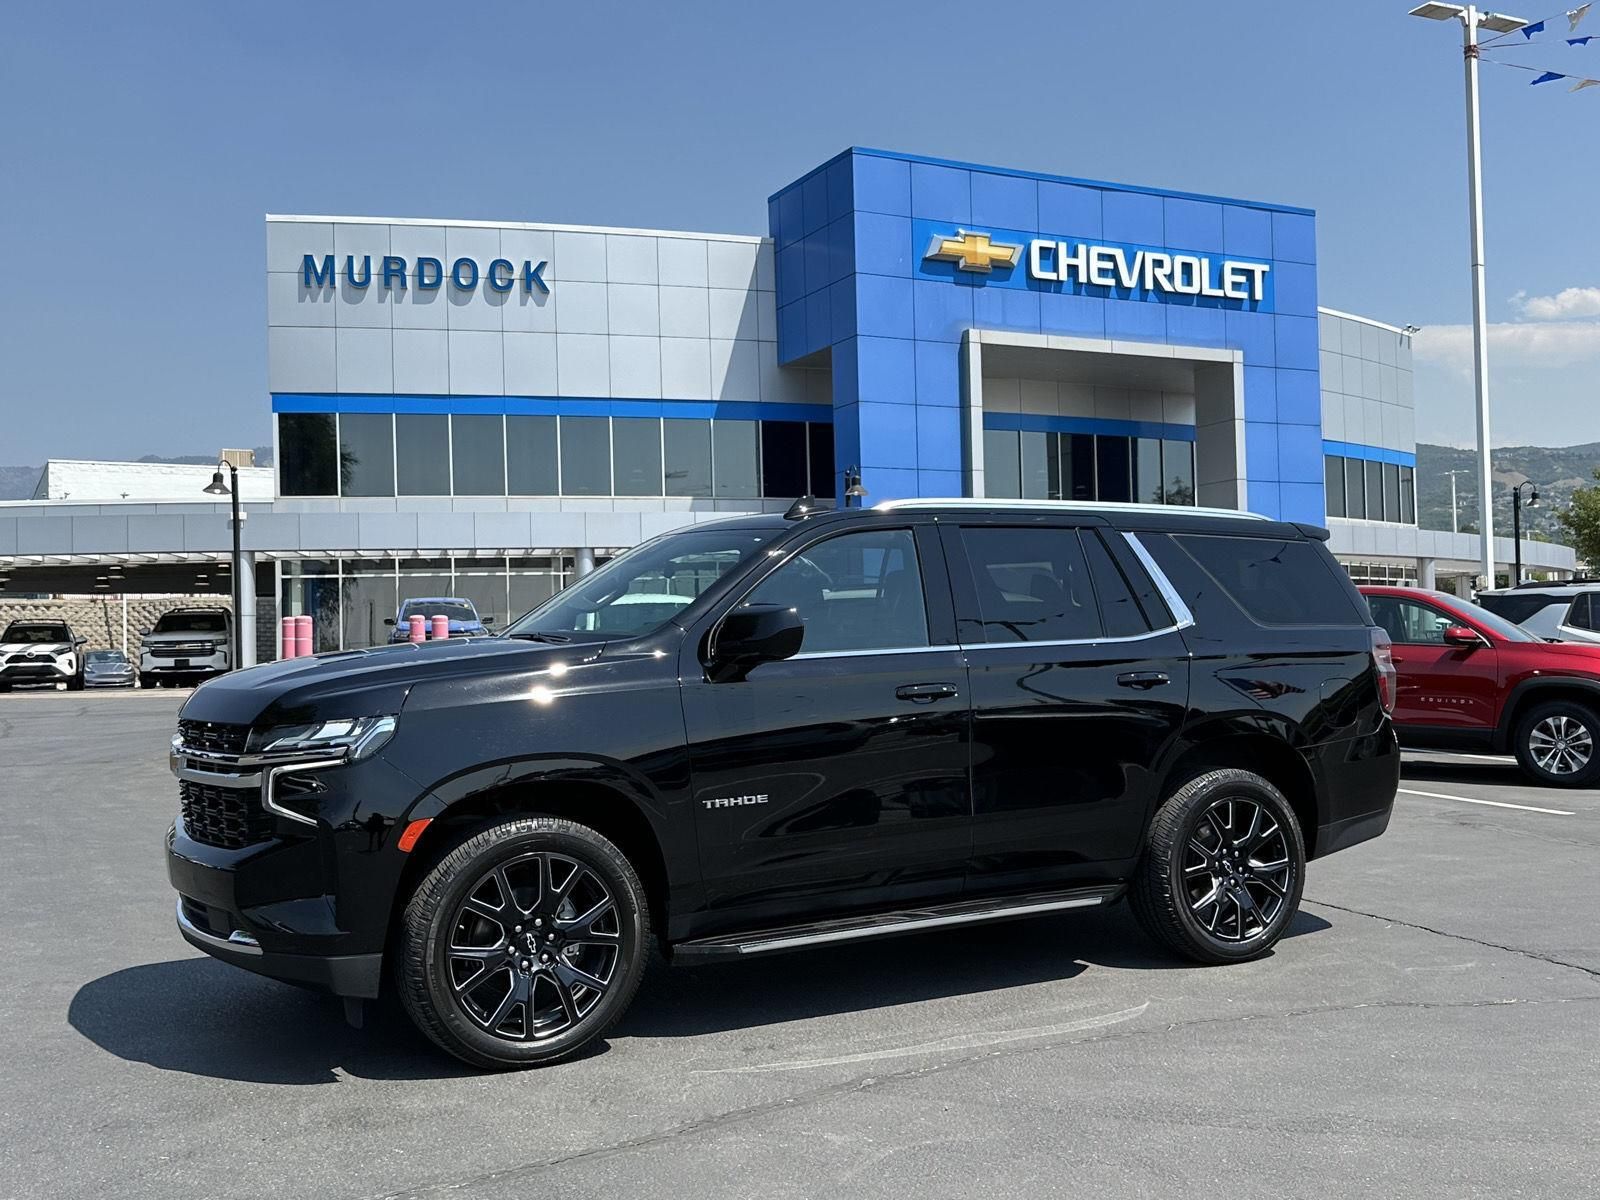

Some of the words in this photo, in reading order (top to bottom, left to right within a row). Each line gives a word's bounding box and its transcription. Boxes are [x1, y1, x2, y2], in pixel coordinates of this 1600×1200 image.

[303, 254, 550, 294] MURDOCK
[1030, 238, 1270, 301] CHEVROLET
[702, 794, 769, 809] TAHOE
